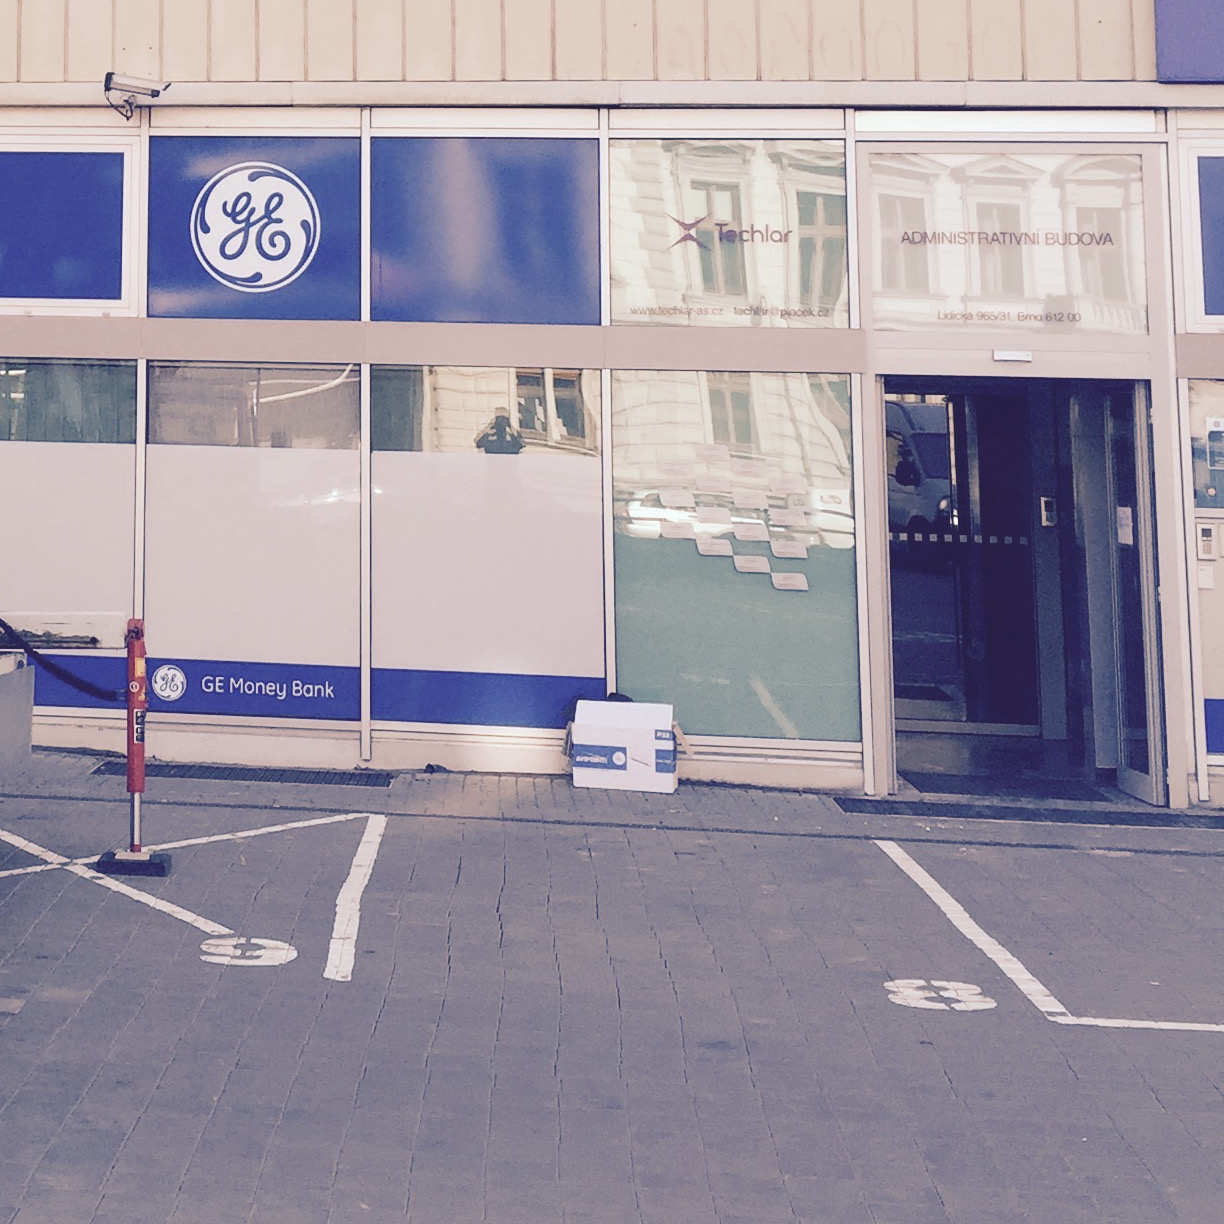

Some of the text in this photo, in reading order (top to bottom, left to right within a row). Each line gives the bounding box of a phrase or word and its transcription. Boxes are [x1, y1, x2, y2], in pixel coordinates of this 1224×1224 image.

[715, 223, 793, 243] Techlar
[901, 228, 1114, 246] ADMINISTRATIVNÍ BUDOVA
[1017, 312, 1043, 322] Brno
[1045, 313, 1064, 323] 612
[1067, 313, 1082, 323] 00
[201, 676, 335, 699] GE Money Bank
[883, 979, 997, 1011] 8
